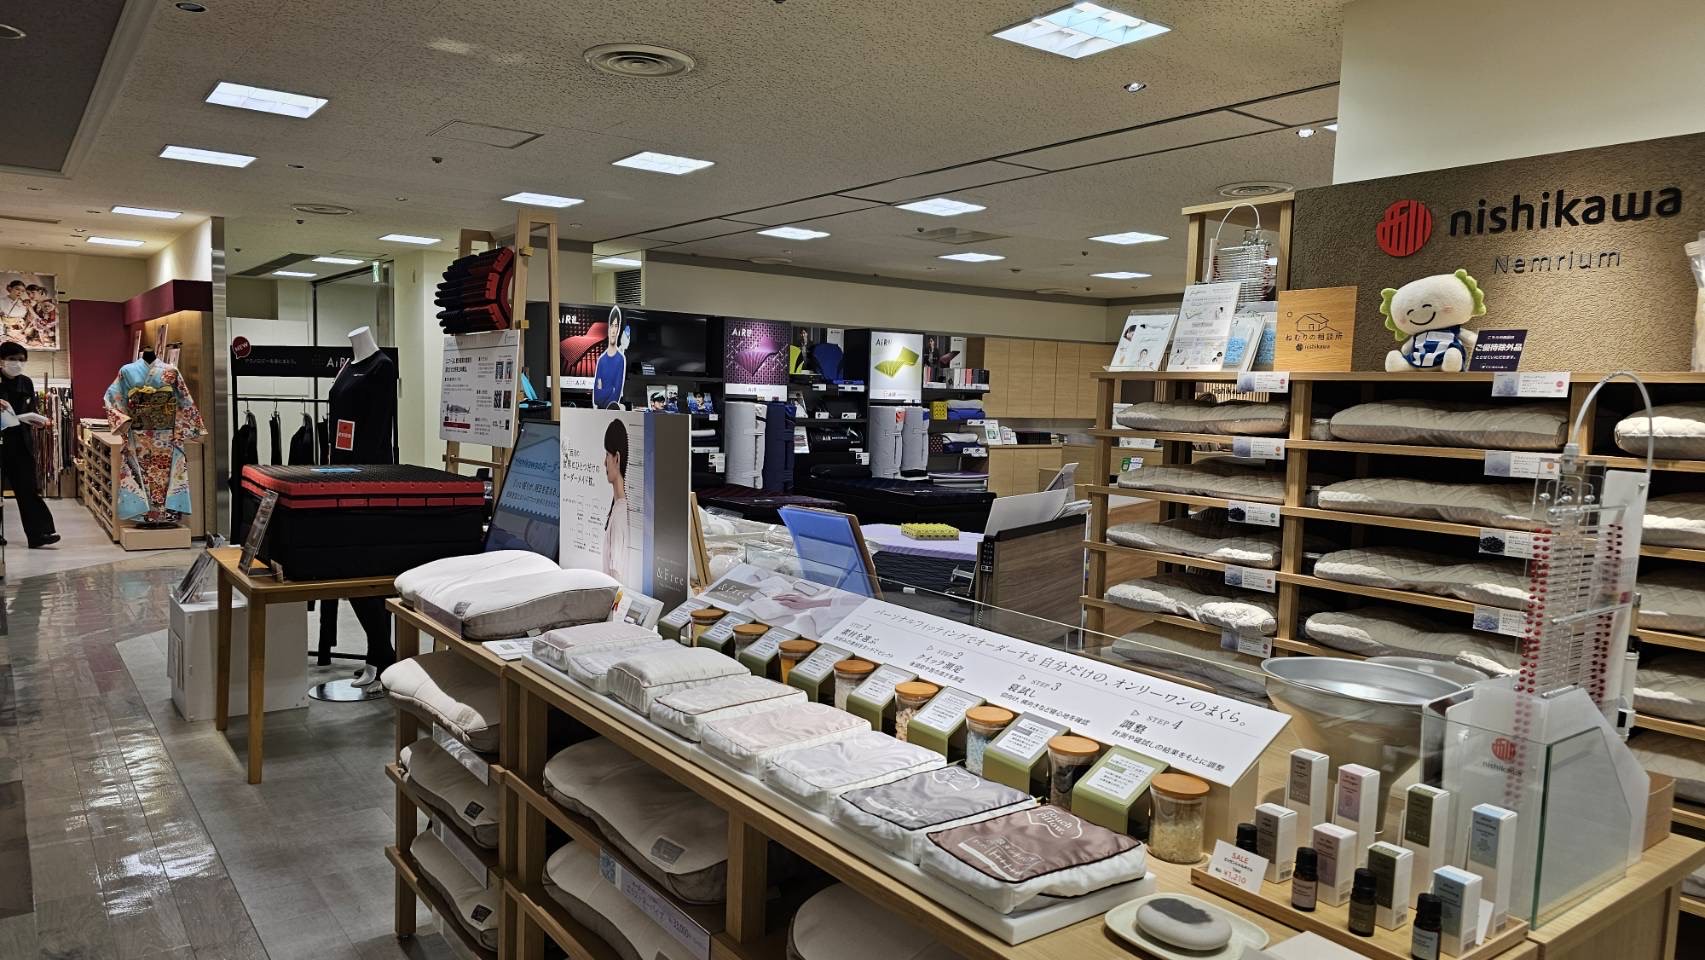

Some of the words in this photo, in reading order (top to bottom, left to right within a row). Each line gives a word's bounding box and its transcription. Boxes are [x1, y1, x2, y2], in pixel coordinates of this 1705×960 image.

[1450, 187, 1682, 238] nishikawa
[1494, 248, 1621, 275] Nemrium
[1285, 332, 1343, 341] ねむりの相談所
[234, 342, 249, 353] NEW
[1475, 343, 1522, 352] ご優待除外品
[656, 567, 685, 586] &Free
[953, 651, 965, 660] 2
[915, 654, 965, 674] クイック測定
[1007, 683, 1036, 699] 寝試し
[1031, 679, 1051, 689] STEP
[1050, 682, 1062, 692] 3
[1119, 719, 1148, 736] 調整
[1146, 714, 1170, 727] STEP
[1172, 719, 1184, 730] 4
[1111, 729, 1225, 773] 計測や寝試しの結果をもとに調整
[1231, 852, 1250, 864] SALE
[1222, 870, 1248, 885] ¥1,210
